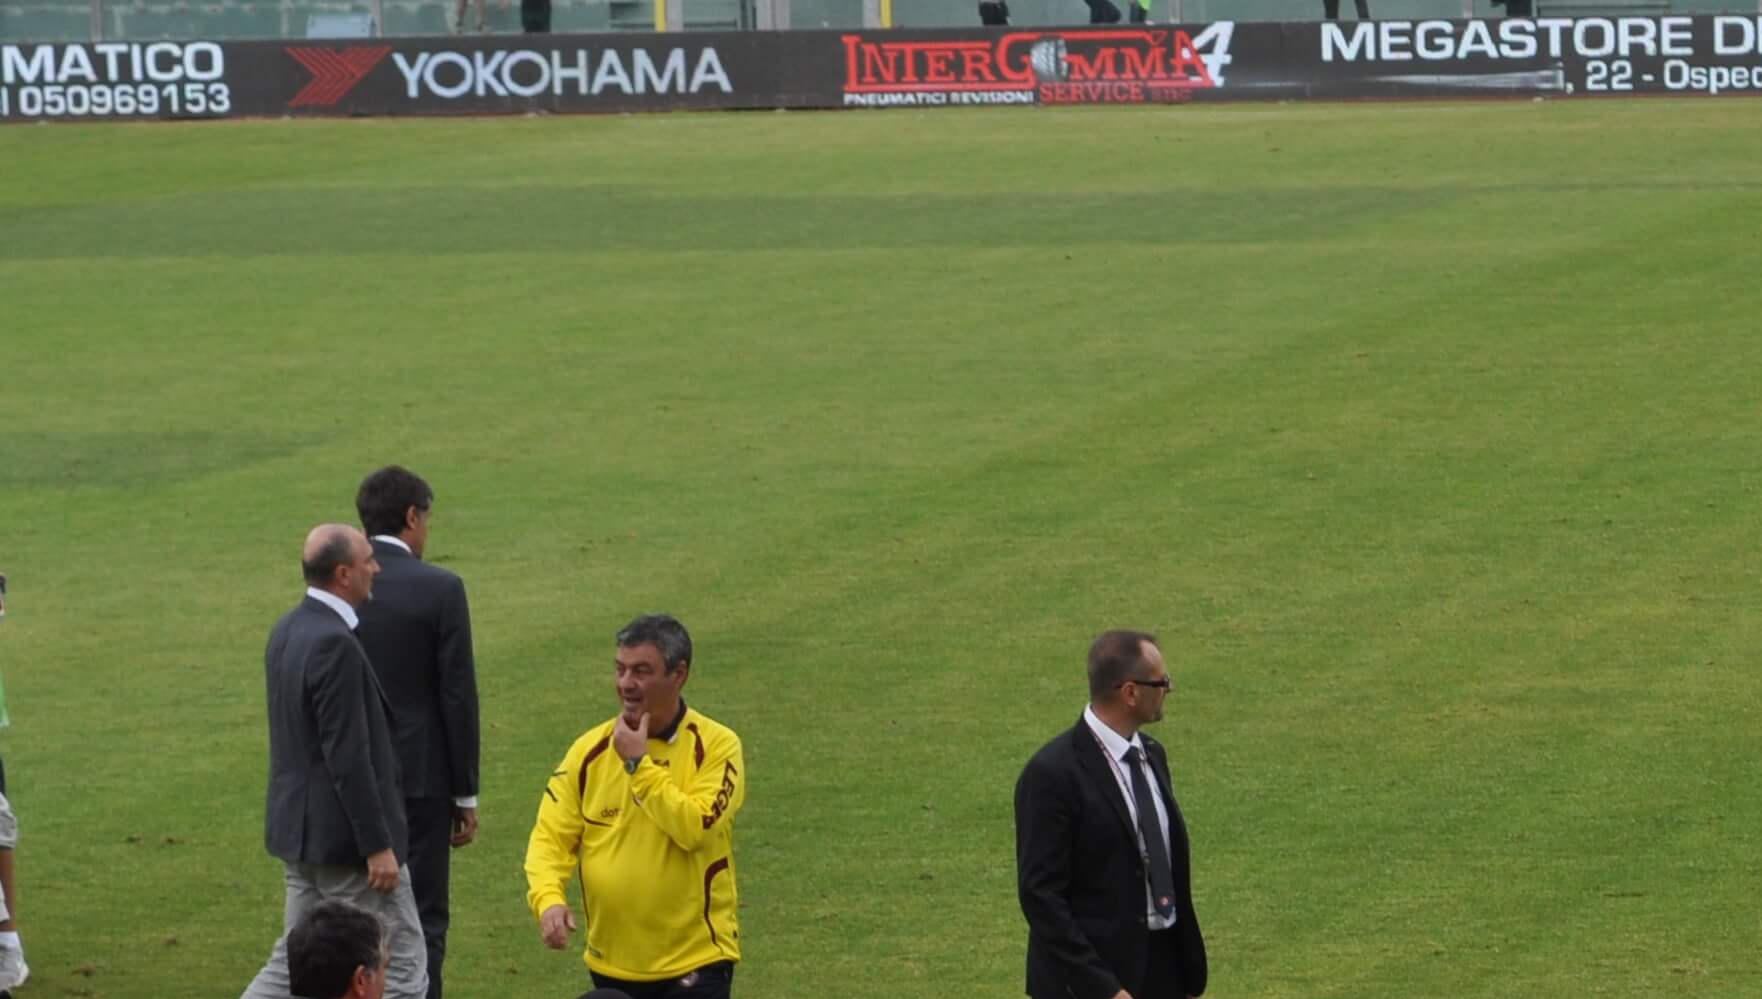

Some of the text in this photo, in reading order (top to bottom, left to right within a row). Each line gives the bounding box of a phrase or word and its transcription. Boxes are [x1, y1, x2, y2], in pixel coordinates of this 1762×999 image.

[1320, 17, 1694, 61] MEGASTORE
[2, 41, 225, 83] MATICO
[392, 47, 733, 98] YOKOHAMA
[1585, 60, 1633, 90] 22
[19, 83, 231, 116] 050969153
[843, 92, 946, 105] PNEUMATICI
[1040, 81, 1144, 103] SERVICE
